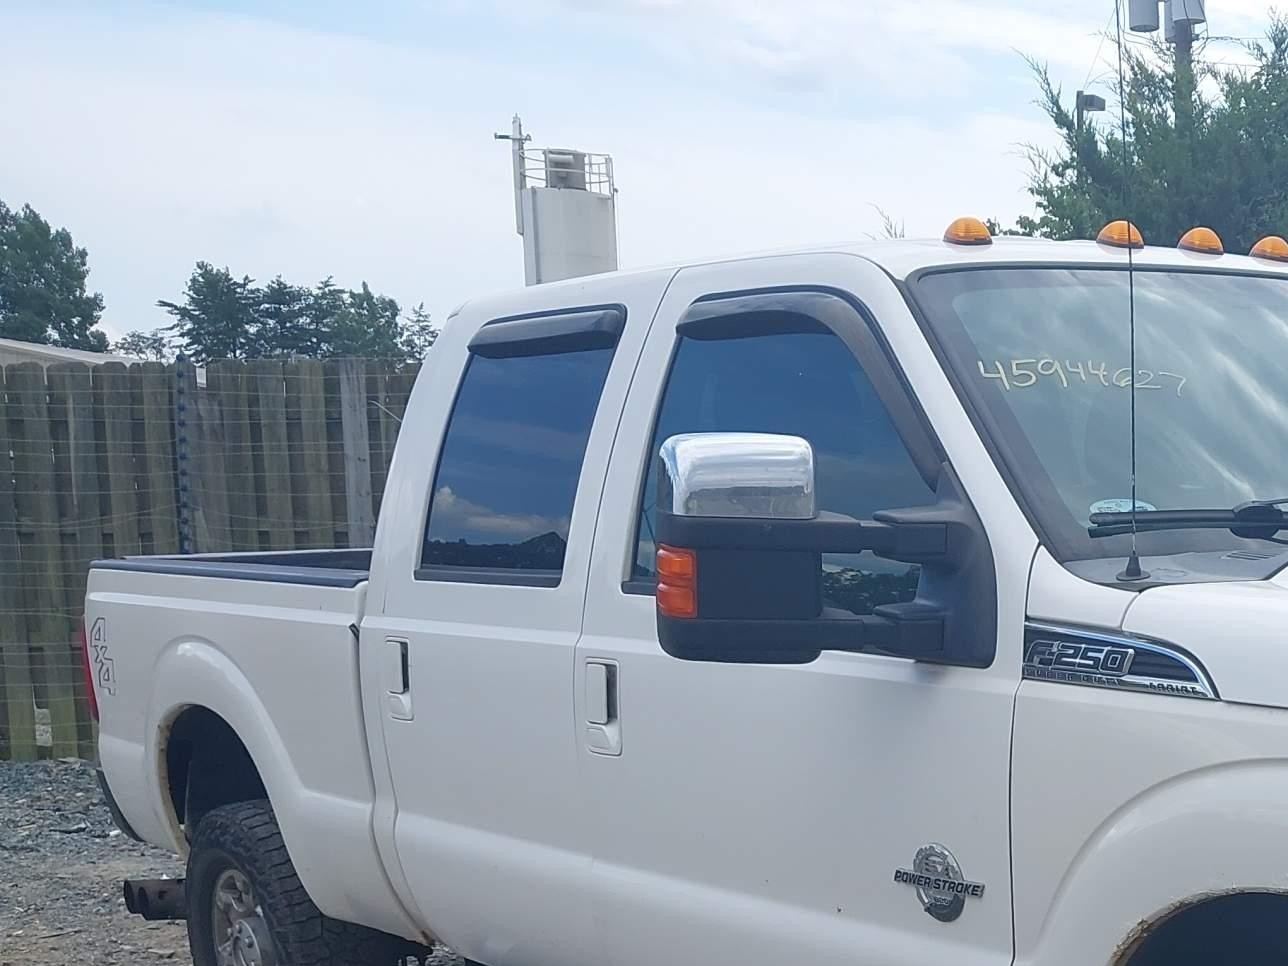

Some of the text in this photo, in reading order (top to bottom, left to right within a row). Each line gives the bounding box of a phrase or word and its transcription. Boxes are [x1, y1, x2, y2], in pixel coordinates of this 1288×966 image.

[978, 359, 1187, 396] 45944627
[894, 870, 981, 896] POWER STROKE
